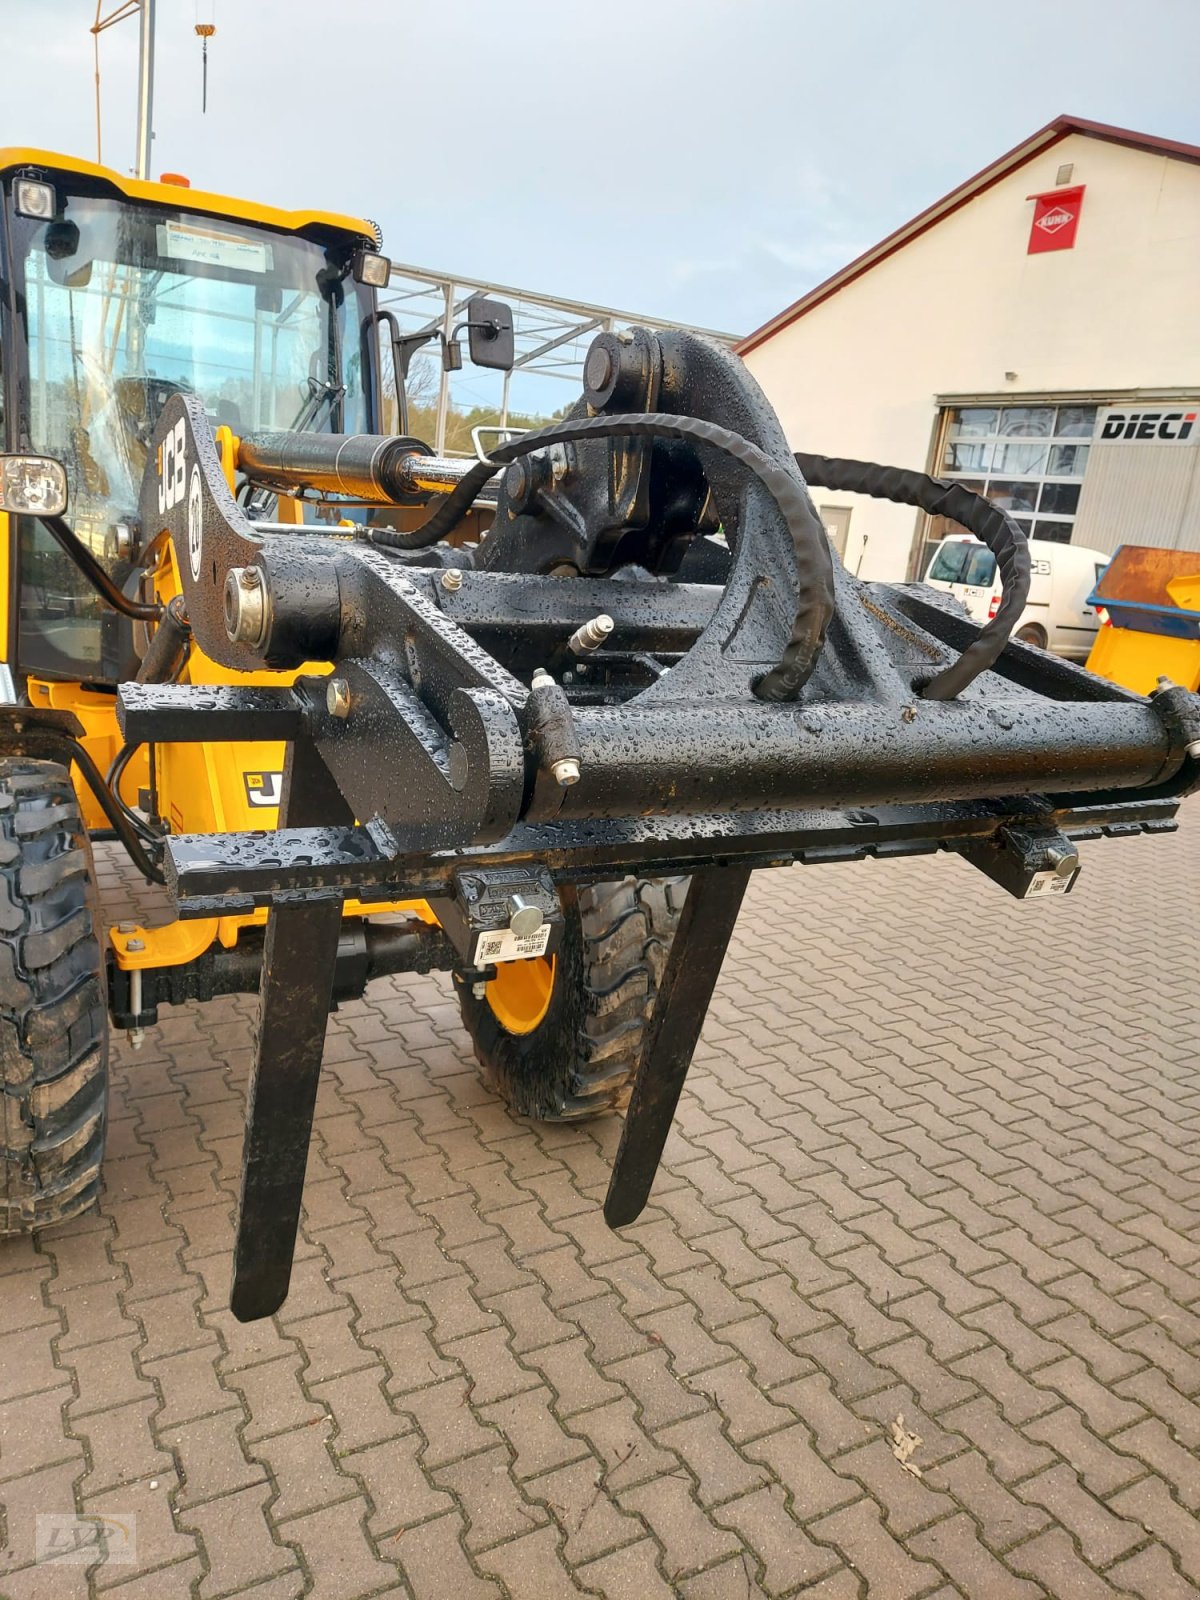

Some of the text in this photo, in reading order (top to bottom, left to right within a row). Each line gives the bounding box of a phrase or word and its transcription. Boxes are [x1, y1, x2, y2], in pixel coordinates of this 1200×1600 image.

[1040, 212, 1070, 227] KUHN
[157, 416, 186, 515] JCB
[1030, 559, 1051, 575] CB
[963, 587, 984, 598] JCB
